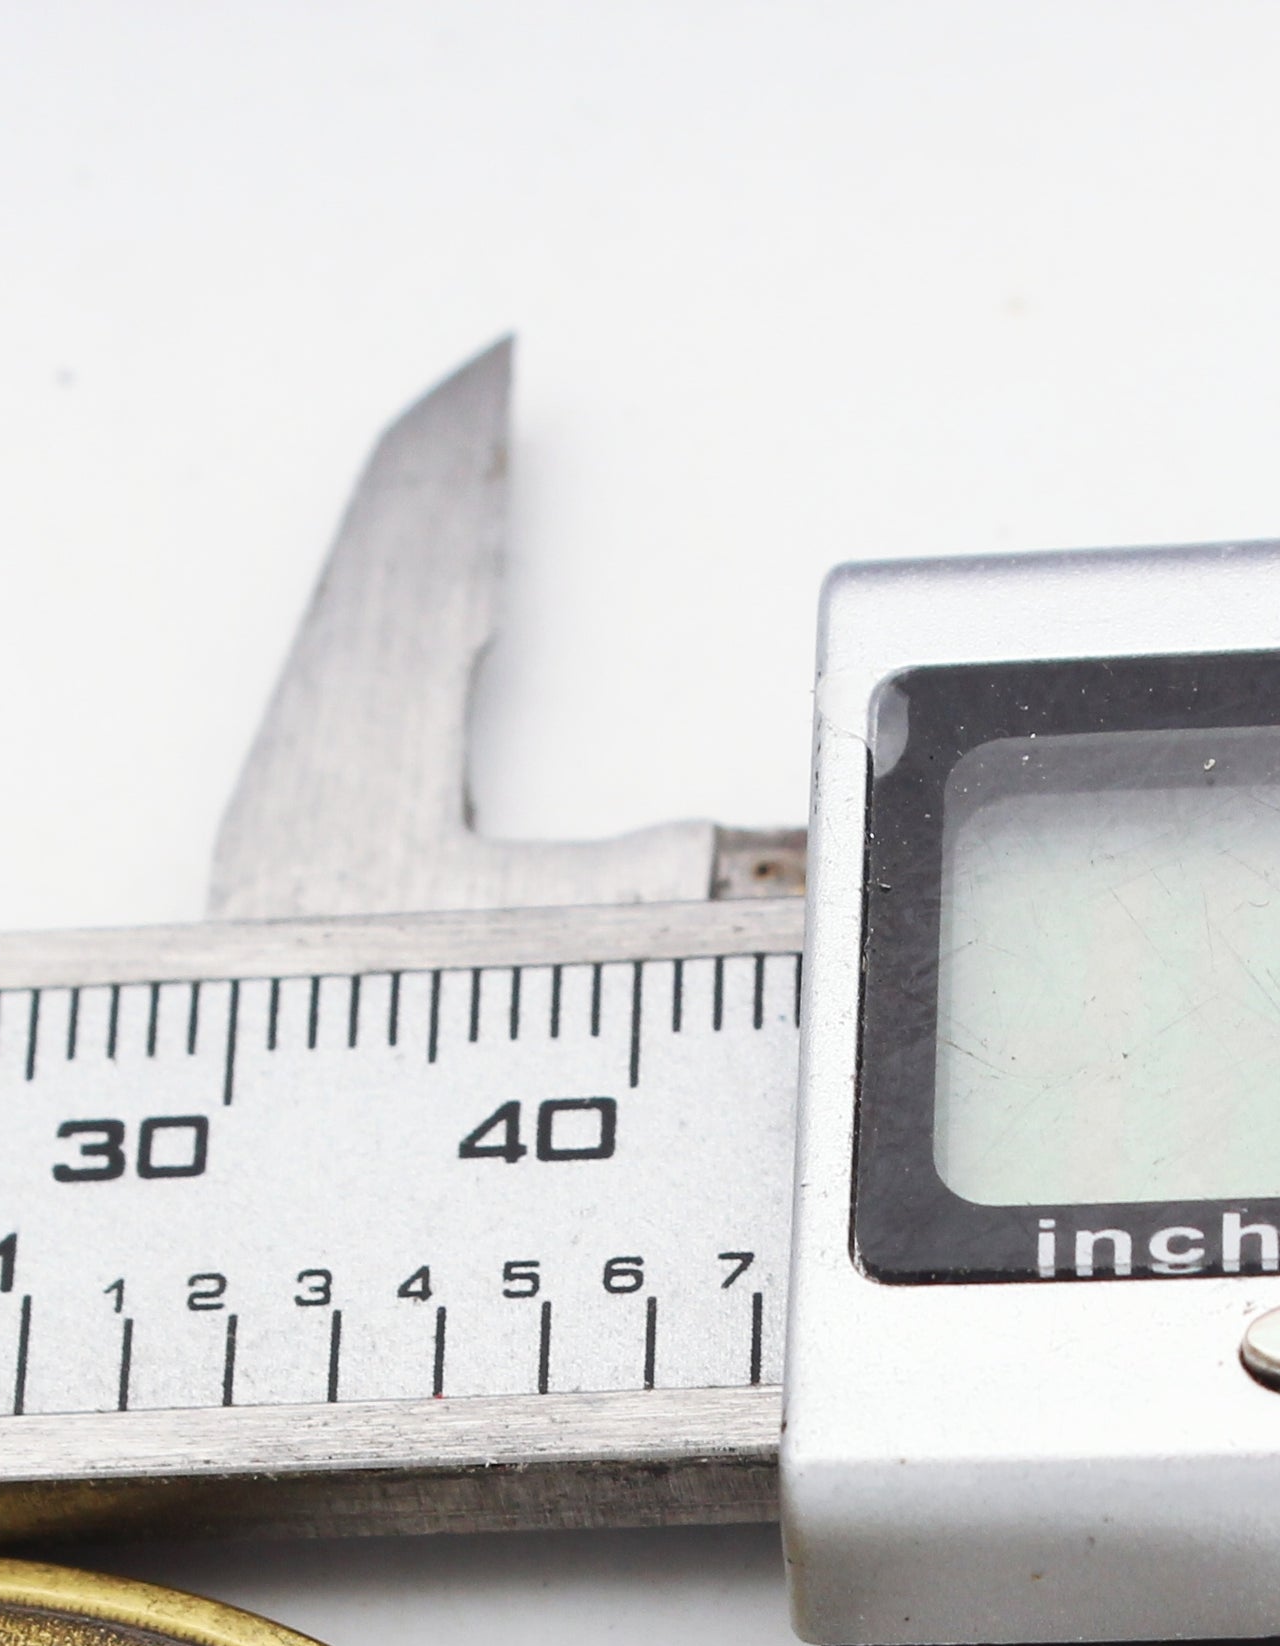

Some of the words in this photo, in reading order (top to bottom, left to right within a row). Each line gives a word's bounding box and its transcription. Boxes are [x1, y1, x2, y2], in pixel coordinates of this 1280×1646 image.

[52, 1115, 209, 1182] 30
[457, 1097, 617, 1163] 40
[104, 1279, 126, 1314] 1
[186, 1273, 227, 1311] 2
[294, 1268, 334, 1307] 3
[397, 1265, 433, 1302] 4
[502, 1260, 541, 1300] 5
[602, 1256, 645, 1294] 6
[718, 1253, 755, 1289] 7
